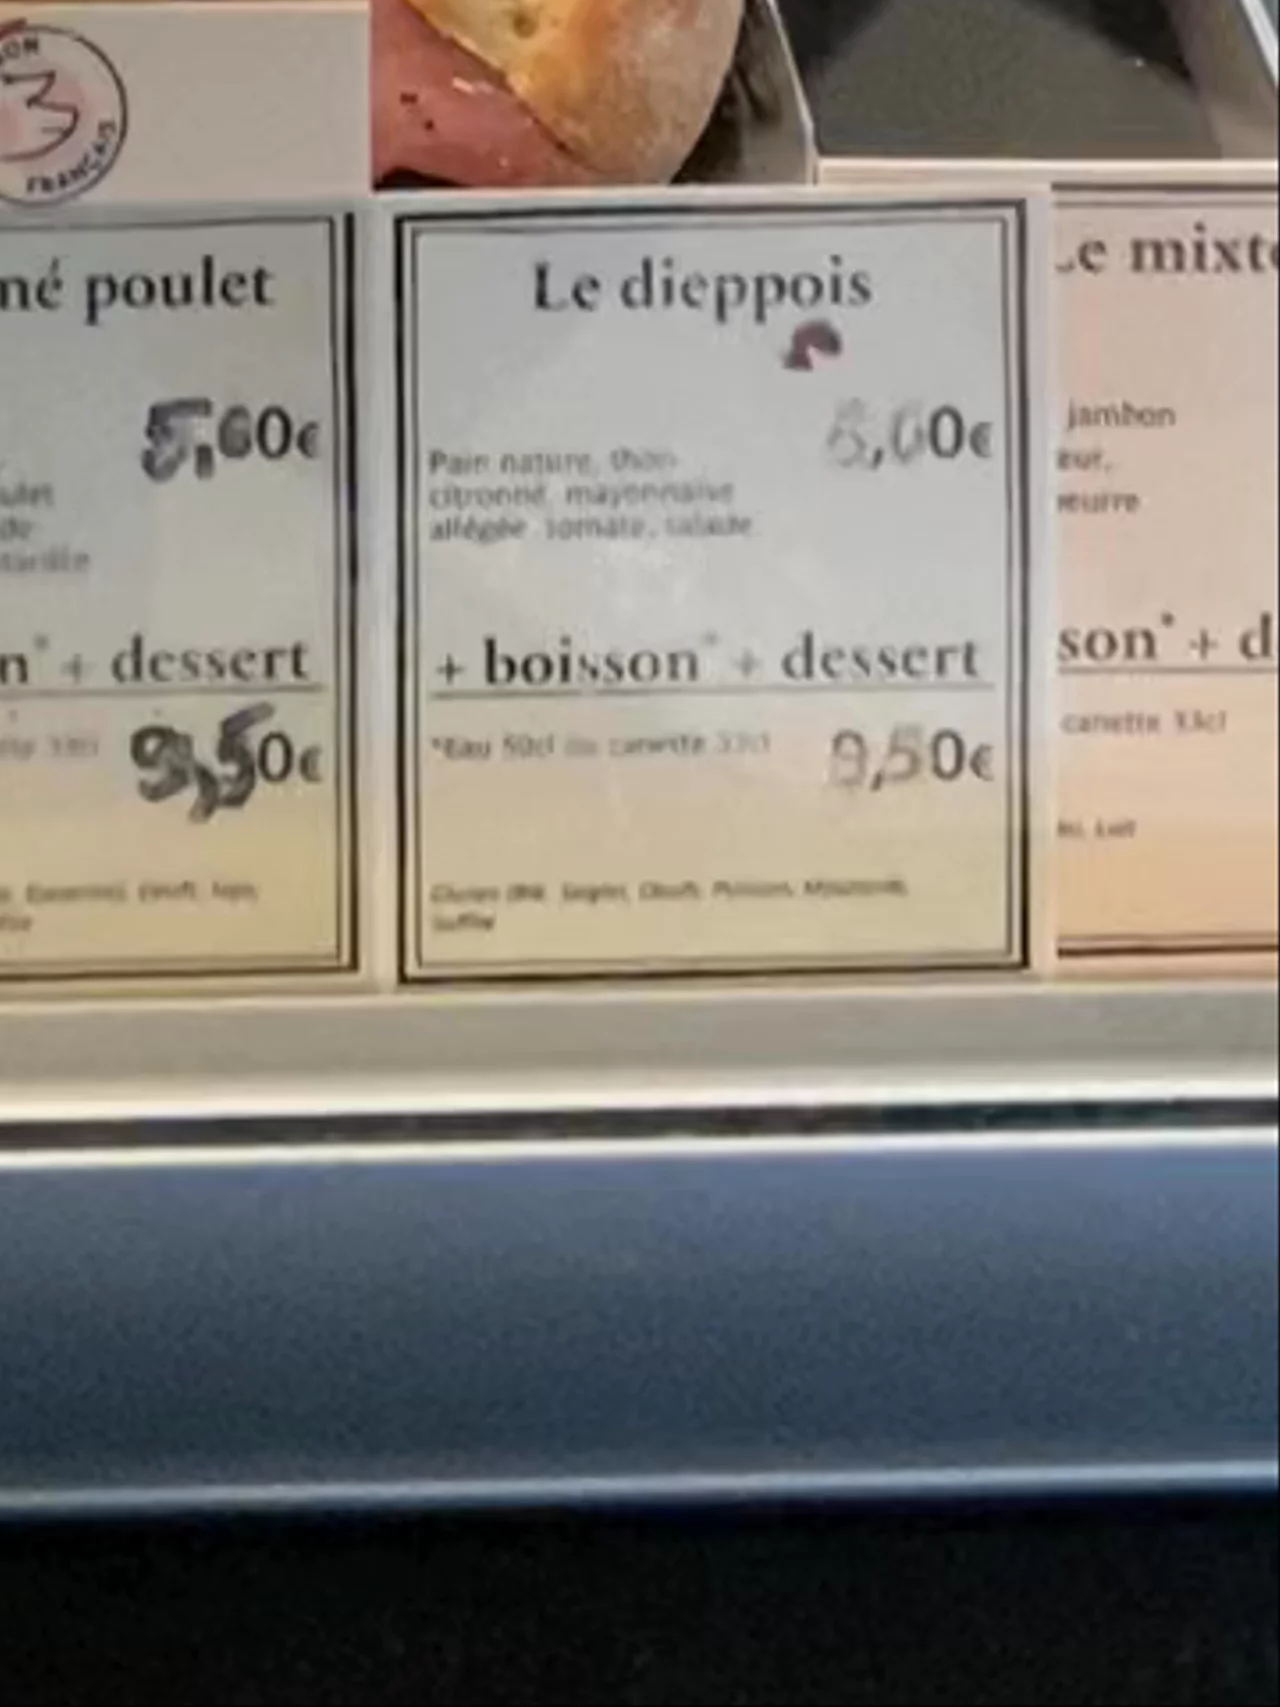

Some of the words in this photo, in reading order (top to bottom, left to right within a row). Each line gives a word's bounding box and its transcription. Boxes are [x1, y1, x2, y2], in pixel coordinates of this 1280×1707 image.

[1054, 237, 1108, 277] e
[85, 256, 275, 325] poulet
[535, 262, 600, 312] Le
[620, 255, 873, 323] dieppois
[1066, 397, 1177, 431] jambon
[63, 652, 92, 679] +
[111, 632, 309, 683] dessert
[436, 655, 466, 682] +
[783, 630, 981, 682] dessert
[1189, 626, 1220, 661] +
